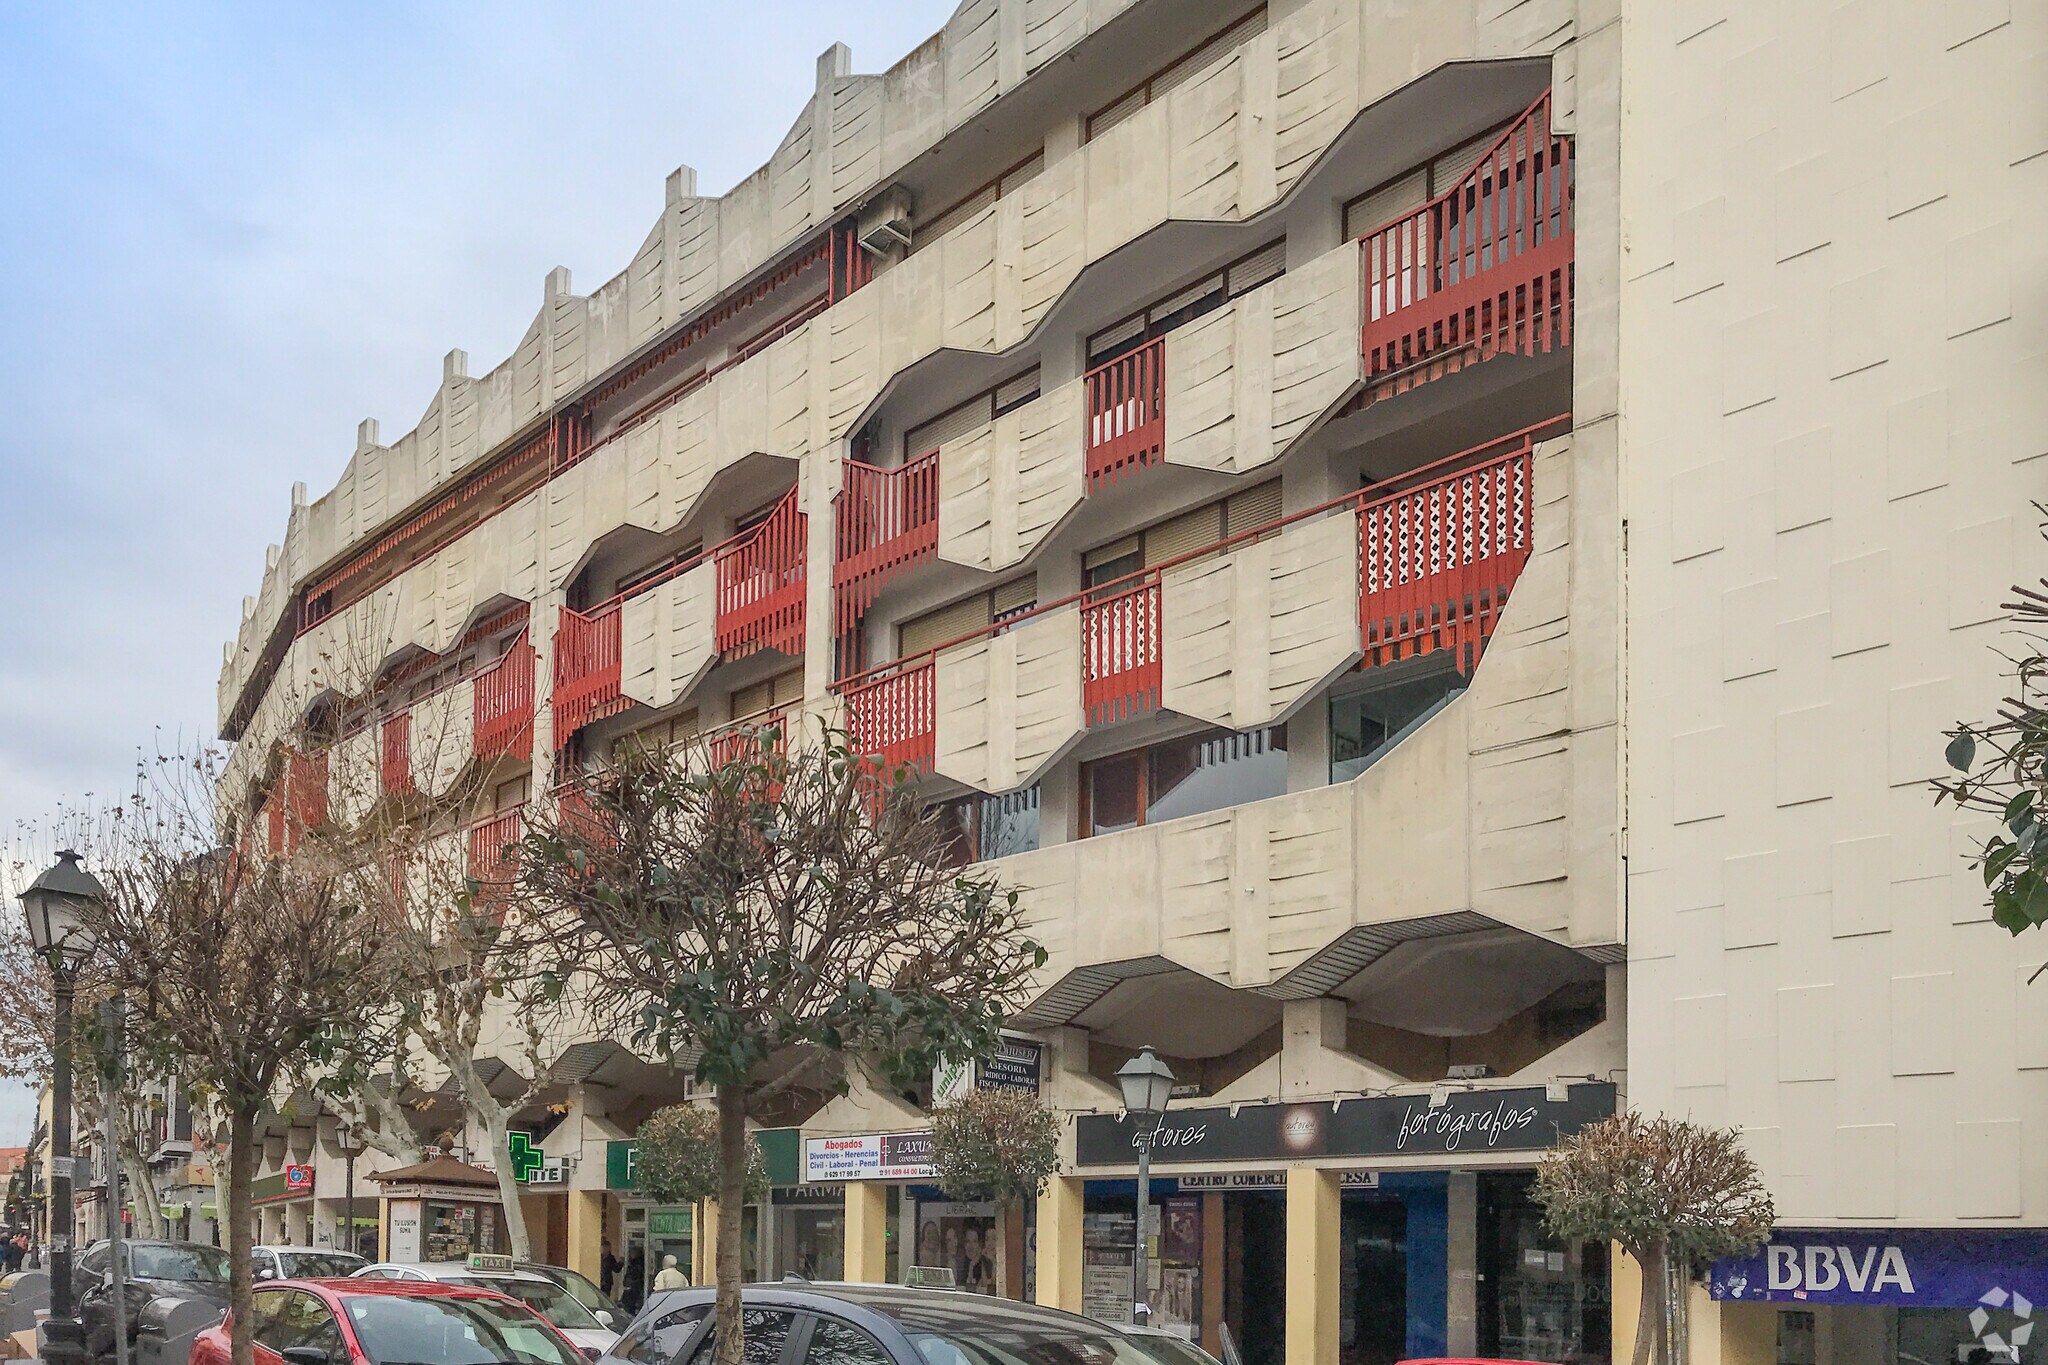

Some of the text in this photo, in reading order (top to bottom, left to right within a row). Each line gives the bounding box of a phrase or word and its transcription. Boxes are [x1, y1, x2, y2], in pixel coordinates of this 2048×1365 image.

[987, 1062, 1027, 1075] ASESORIA
[1010, 1074, 1037, 1085] LABORAL
[824, 1139, 863, 1151] Abogados
[809, 1149, 878, 1160] Divorcios Herencias
[809, 1159, 878, 1169] Civil Laboral Penal
[1183, 1175, 1227, 1187] CENTRO
[1233, 1174, 1287, 1186] COMERCI
[483, 1258, 504, 1267] TAXI
[1768, 1245, 1915, 1293] BBVA
